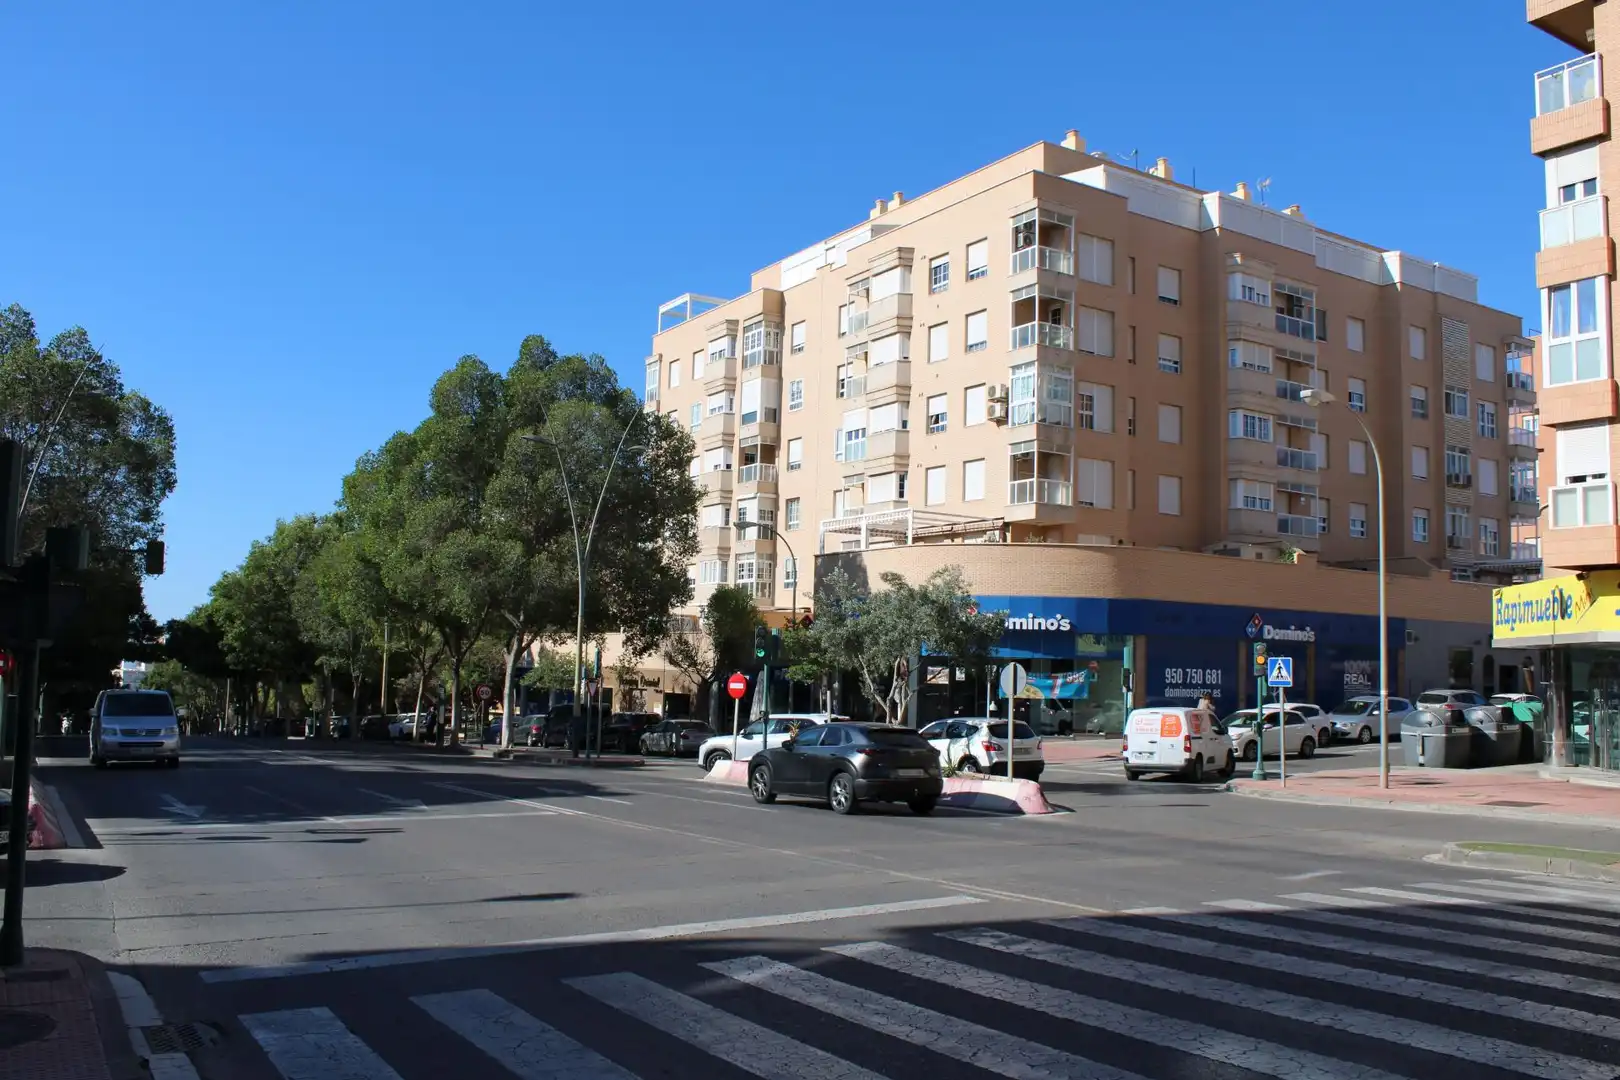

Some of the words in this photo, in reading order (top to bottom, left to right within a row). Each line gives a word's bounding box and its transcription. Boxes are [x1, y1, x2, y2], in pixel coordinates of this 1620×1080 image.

[1495, 587, 1573, 631] Rapimueble
[1003, 612, 1071, 631] mino's
[1262, 624, 1316, 642] Domino's
[1165, 667, 1183, 684] 950
[1186, 668, 1203, 684] 750
[1205, 669, 1222, 685] 681
[1343, 673, 1371, 685] REAL
[480, 689, 490, 697] 50
[1164, 686, 1221, 699] dominospizzes
